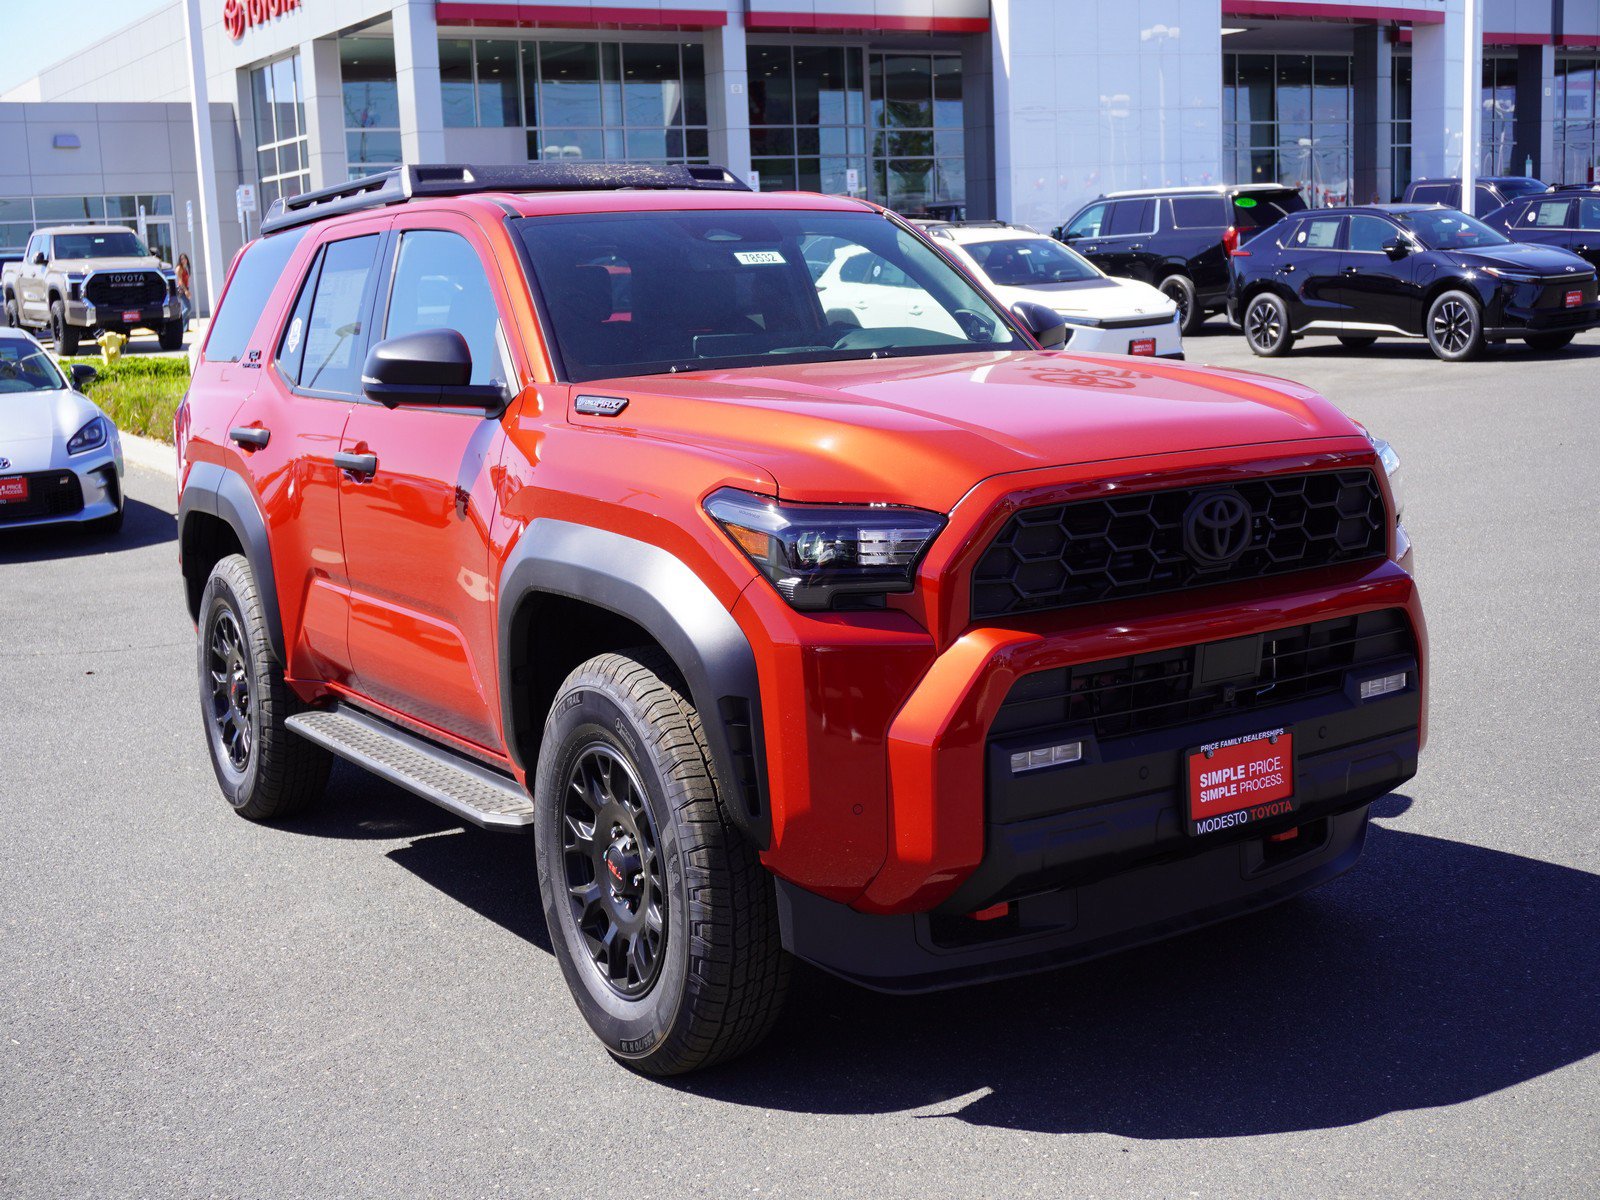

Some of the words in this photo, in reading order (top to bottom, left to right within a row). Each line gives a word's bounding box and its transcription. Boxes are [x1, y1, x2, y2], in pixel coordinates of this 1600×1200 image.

[742, 253, 778, 263] 78532
[109, 274, 146, 284] TOYOTA
[1200, 742, 1219, 752] PRICE
[1220, 737, 1242, 748] FAMILY
[1243, 728, 1284, 743] DEALERSHIPS
[1200, 765, 1245, 788] SIMPLE
[1249, 756, 1284, 777] PRICE.
[1200, 784, 1237, 803] SIMPLE
[1240, 773, 1285, 793] PROCESS.
[1197, 811, 1247, 835] MODESTO
[1250, 800, 1293, 820] TOYOTA
